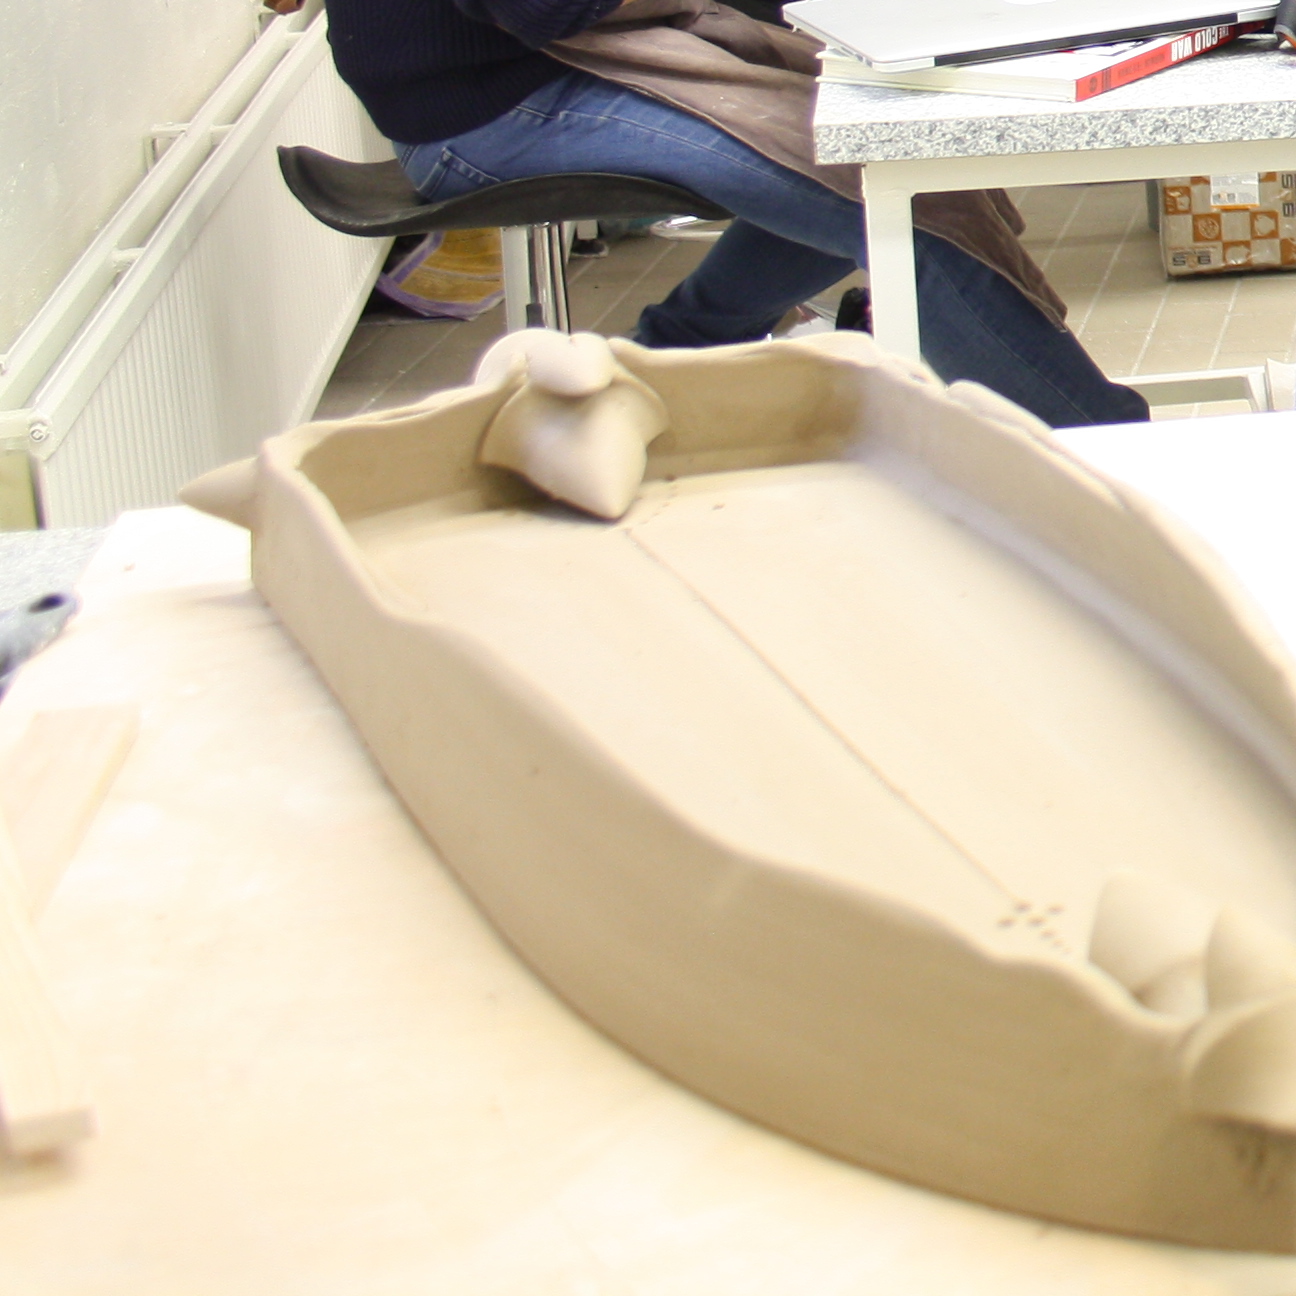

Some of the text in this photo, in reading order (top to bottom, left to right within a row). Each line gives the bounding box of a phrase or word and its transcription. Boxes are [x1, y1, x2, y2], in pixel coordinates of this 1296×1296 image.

[1171, 26, 1229, 62] THE COLD WAR
